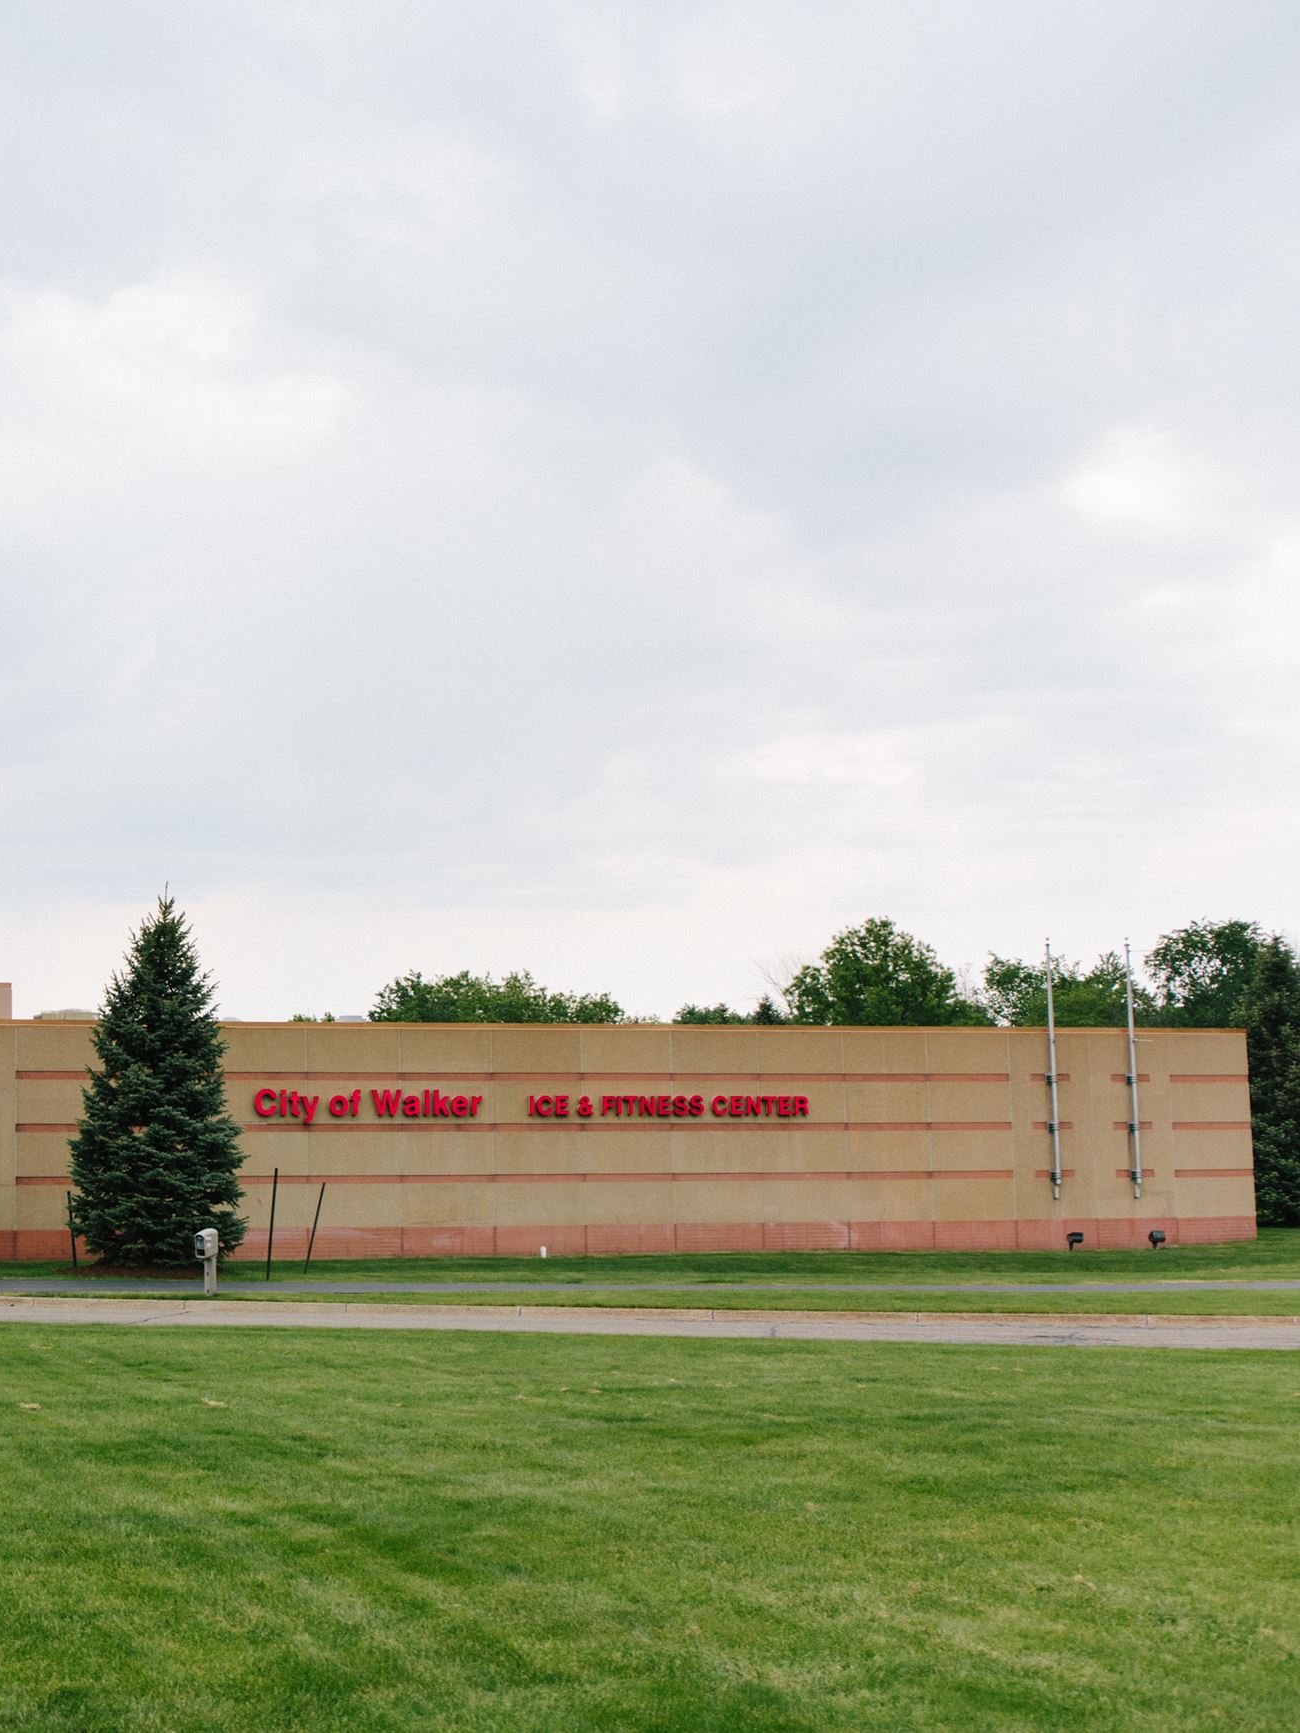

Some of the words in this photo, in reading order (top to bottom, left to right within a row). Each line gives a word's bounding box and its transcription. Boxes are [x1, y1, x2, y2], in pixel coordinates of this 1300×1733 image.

[254, 1088, 319, 1123] City
[329, 1089, 362, 1116] of
[371, 1088, 483, 1117] Walker
[529, 1094, 570, 1117] ICE
[577, 1094, 595, 1117] &
[601, 1094, 705, 1117] FITNESS
[711, 1094, 810, 1116] CENTER
